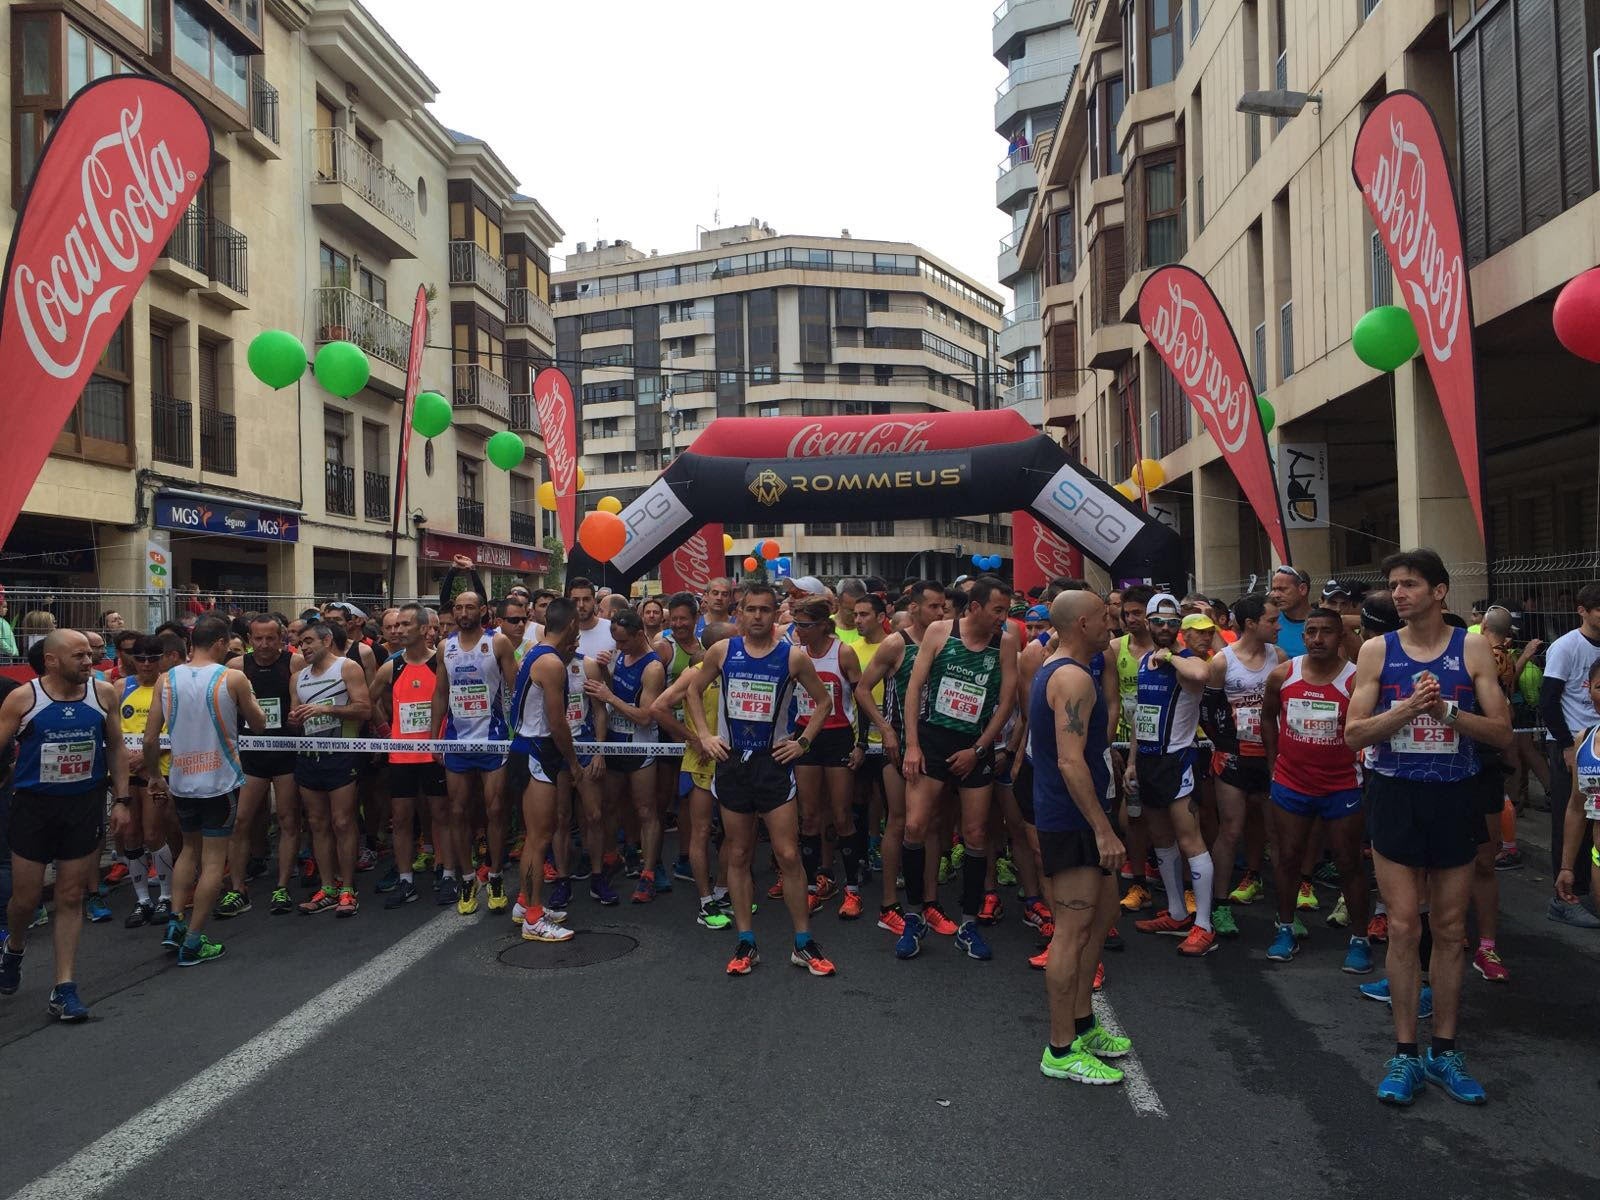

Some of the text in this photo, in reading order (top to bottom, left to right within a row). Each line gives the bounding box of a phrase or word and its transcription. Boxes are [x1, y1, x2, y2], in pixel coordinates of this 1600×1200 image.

[14, 95, 186, 379] Coca-Cola
[785, 420, 937, 459] Coca-Cola
[790, 468, 961, 492] ROMMEUS
[1052, 480, 1126, 544] SPG
[171, 506, 247, 531] MGS Seguros
[257, 518, 279, 535] MGS
[946, 664, 974, 677] urban
[454, 693, 486, 701] HASSANE
[730, 691, 772, 701] CARMELIN
[943, 688, 978, 703] ANTONIO
[1302, 691, 1325, 699] Joma
[469, 702, 482, 710] 46
[749, 702, 764, 713] 12
[957, 701, 972, 712] 65
[1304, 720, 1332, 731] 1368
[1423, 729, 1446, 742] 25
[253, 740, 266, 748] PASO
[272, 740, 297, 748] PROHIBIDO
[389, 742, 415, 751] PROHIBIDO
[623, 746, 648, 755] PROHIBIDO
[57, 754, 82, 763] PACO
[69, 763, 84, 774] 11
